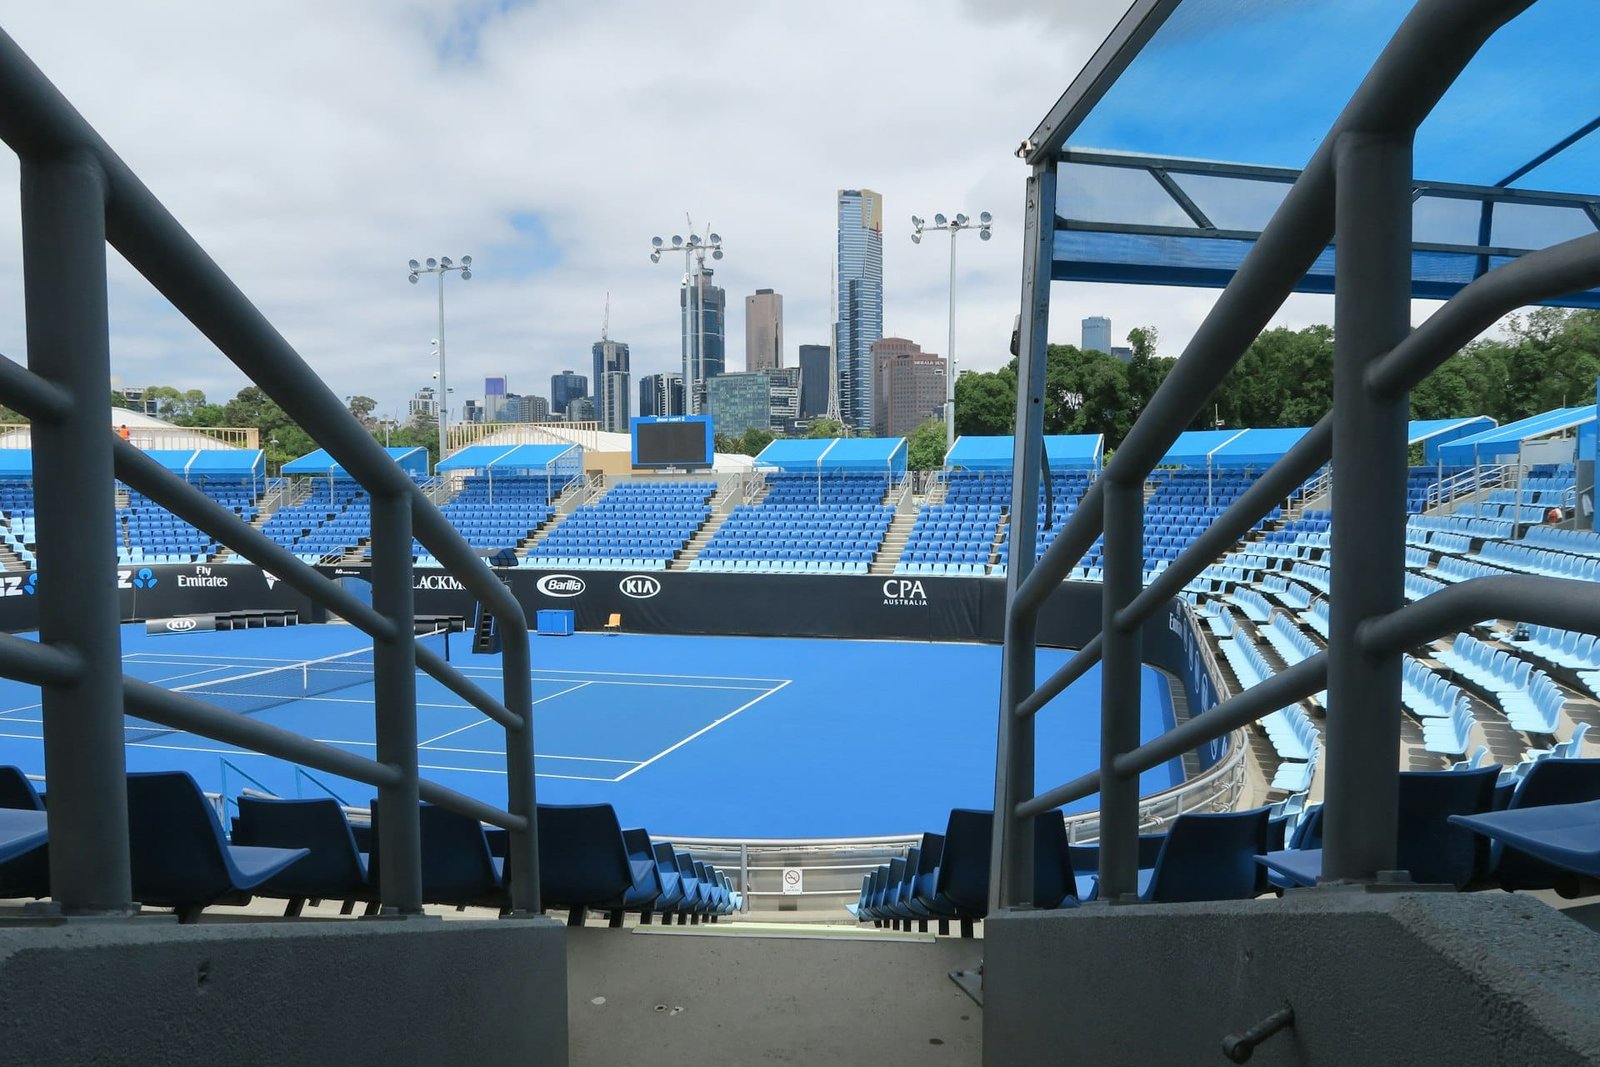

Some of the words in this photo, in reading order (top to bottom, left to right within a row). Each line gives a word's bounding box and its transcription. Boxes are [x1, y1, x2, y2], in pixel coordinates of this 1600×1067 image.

[196, 566, 212, 576] Fly
[177, 575, 228, 587] Emirates
[412, 575, 466, 590] LACKM
[548, 579, 582, 591] Barilla
[626, 580, 654, 593] KIA
[883, 579, 927, 599] CPA
[171, 621, 191, 629] KIA
